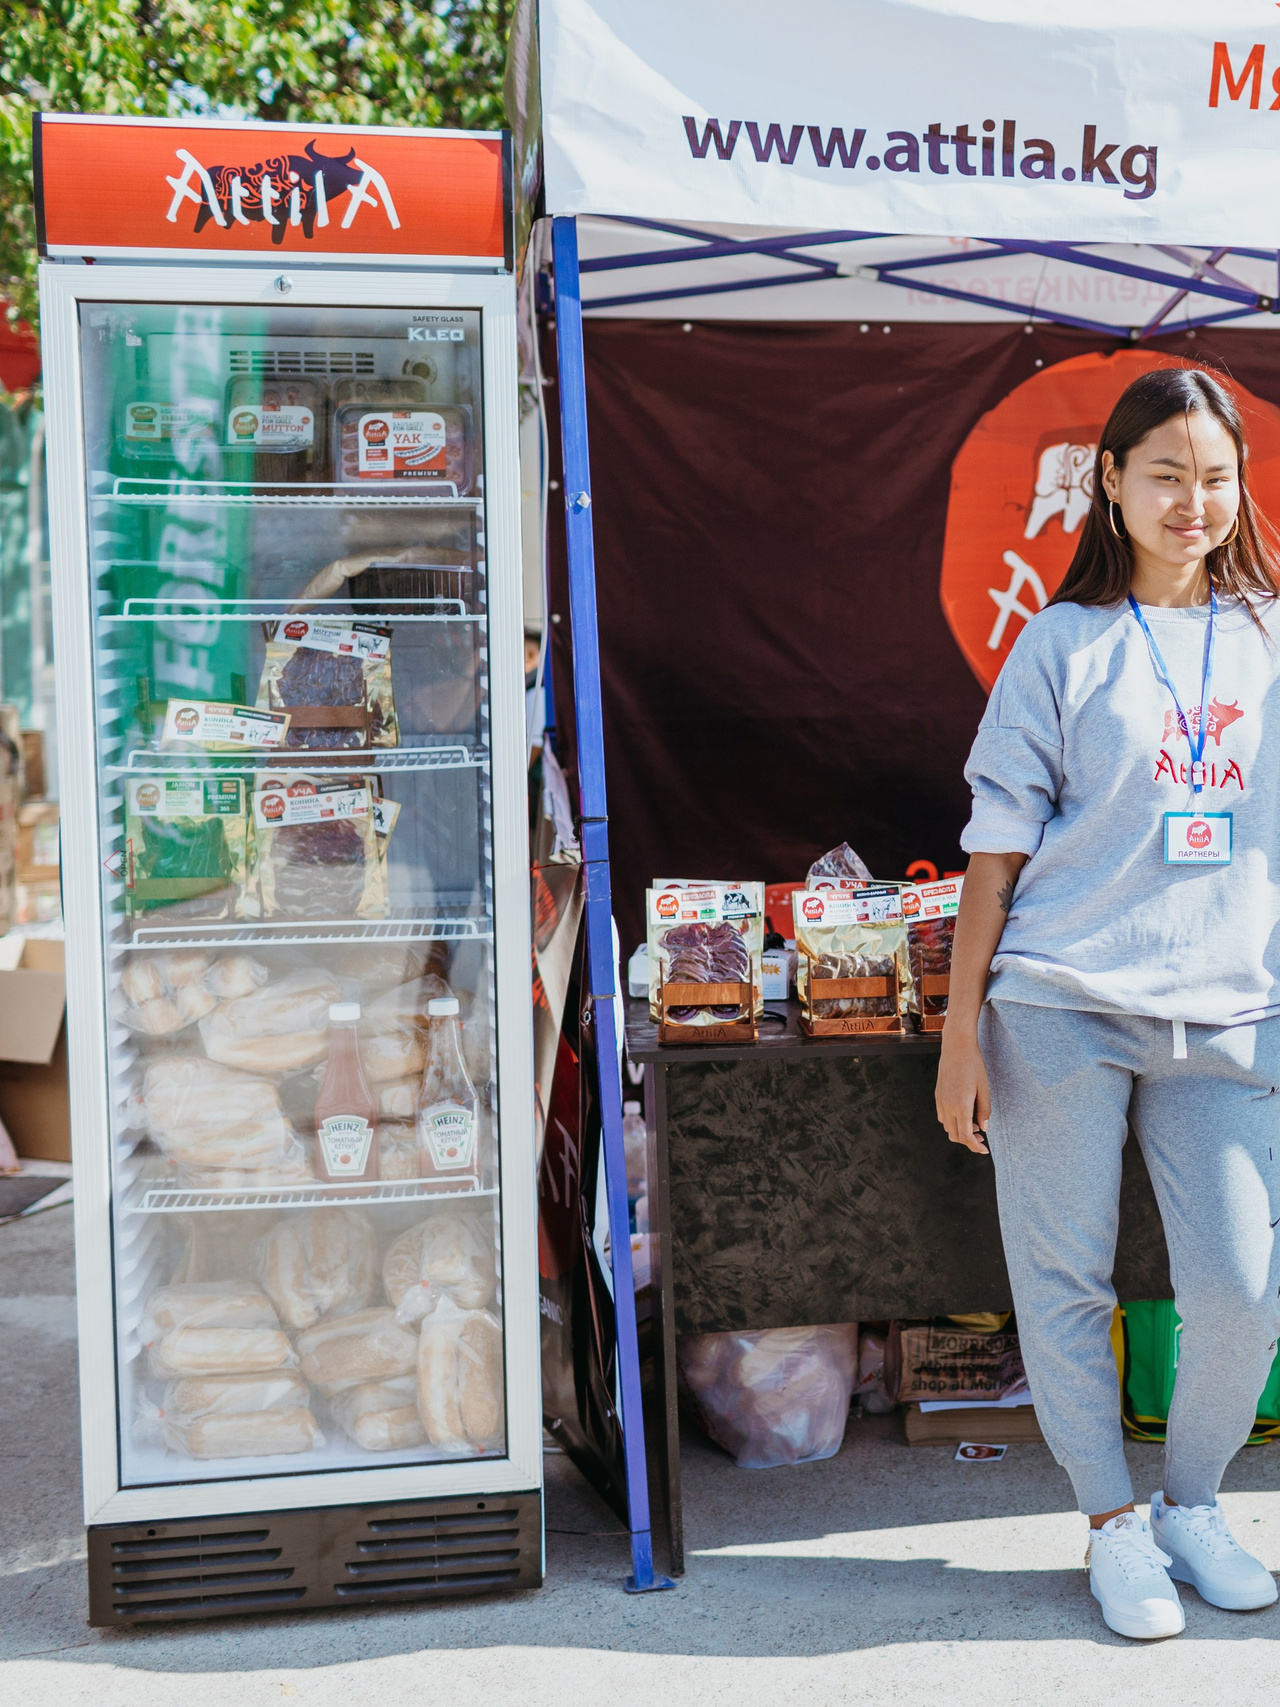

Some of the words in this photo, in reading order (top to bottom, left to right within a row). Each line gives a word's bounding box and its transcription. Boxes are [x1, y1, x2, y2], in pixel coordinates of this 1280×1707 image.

[681, 115, 1158, 200] www.attila.kg
[408, 327, 465, 342] KLEO
[394, 433, 422, 444] YAK
[292, 788, 314, 796] УЧА
[1178, 850, 1220, 858] ПАРТНЕРЫ
[120, 850, 128, 877] OPEN
[437, 1116, 465, 1126] HEINZ
[331, 1122, 360, 1132] HEINZ
[911, 1376, 946, 1393] shop
[952, 1379, 966, 1391] at
